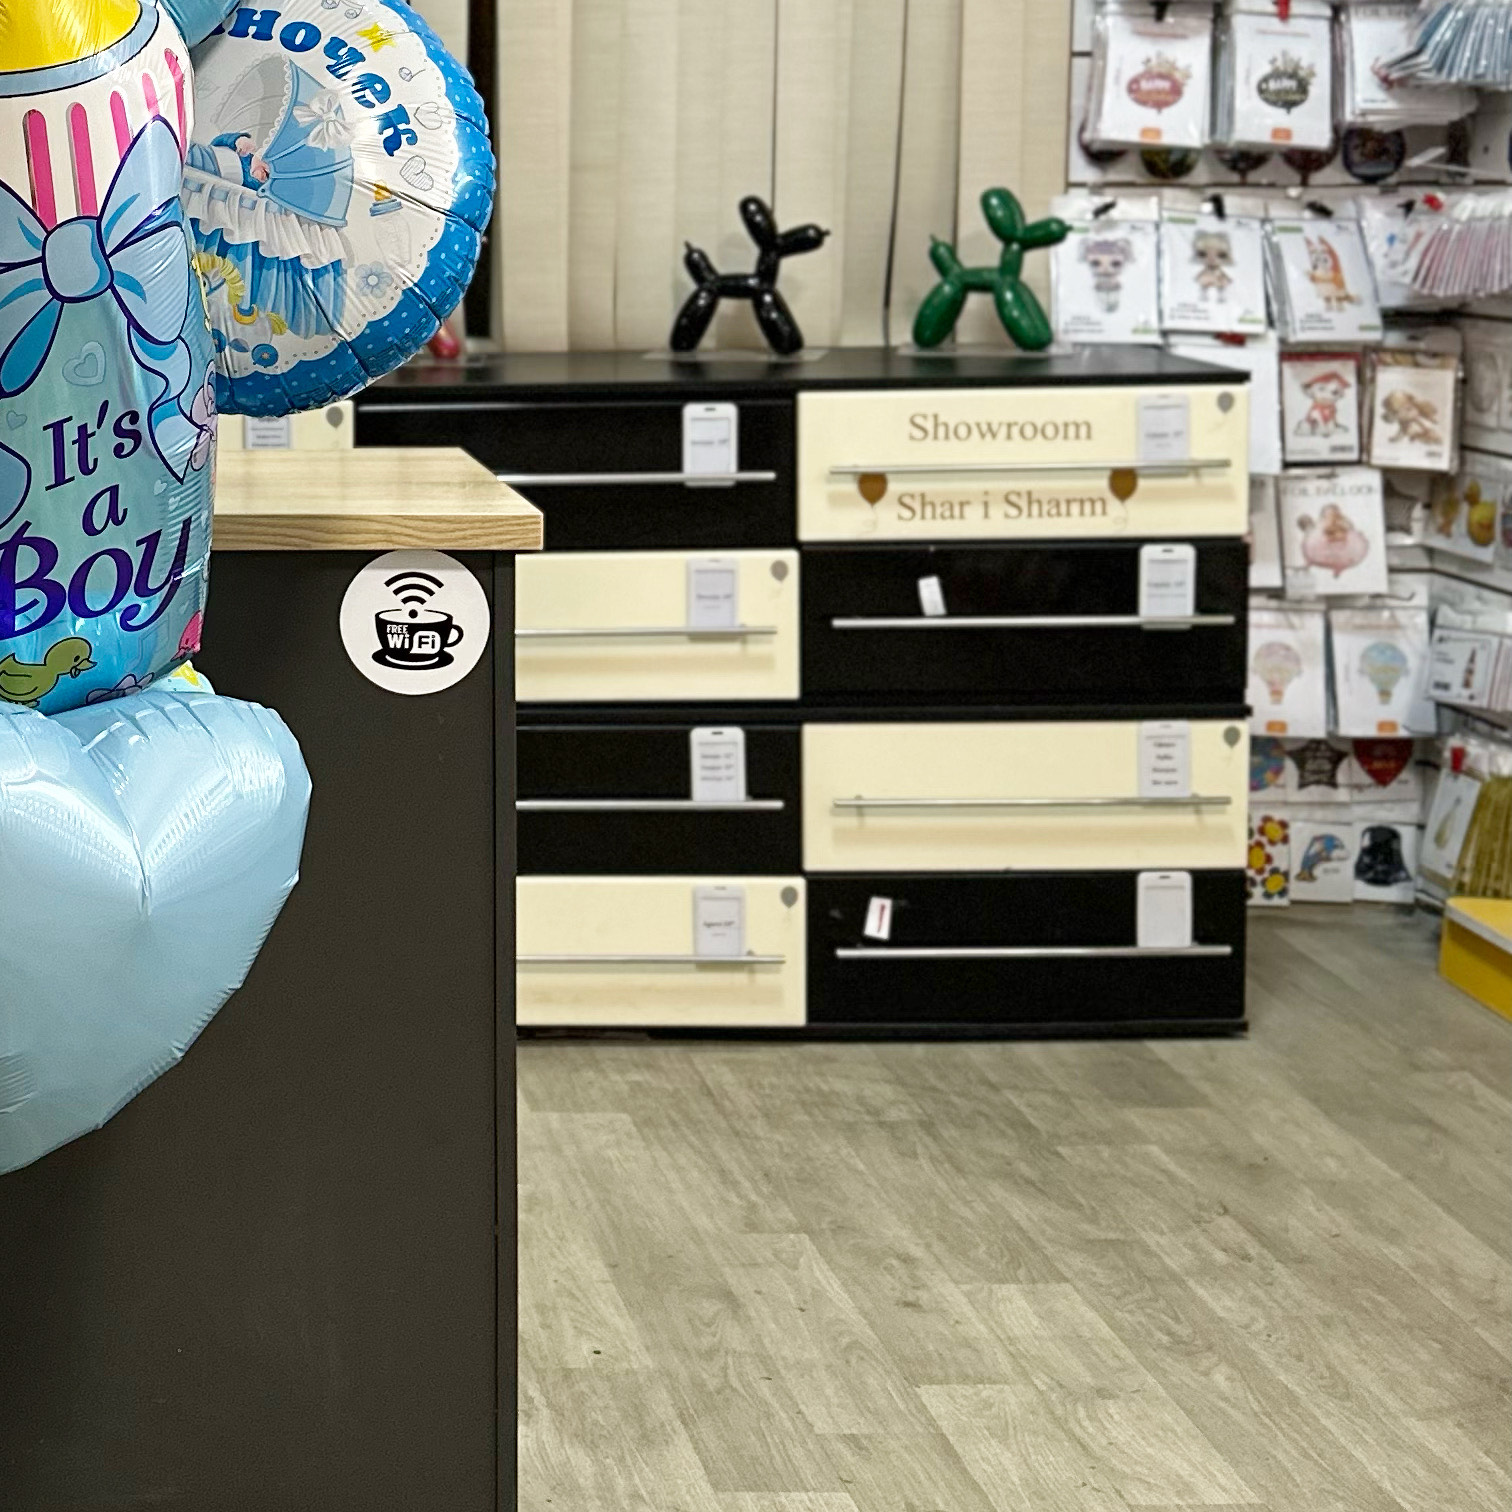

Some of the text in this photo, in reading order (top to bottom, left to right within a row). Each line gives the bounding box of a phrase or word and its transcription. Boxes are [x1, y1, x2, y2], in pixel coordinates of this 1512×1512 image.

[216, 7, 419, 157] ночек
[42, 400, 143, 491] It's
[908, 413, 1094, 443] Showroom
[82, 484, 128, 536] a
[896, 489, 1109, 522] Shar i Sharm
[386, 624, 409, 634] FREE
